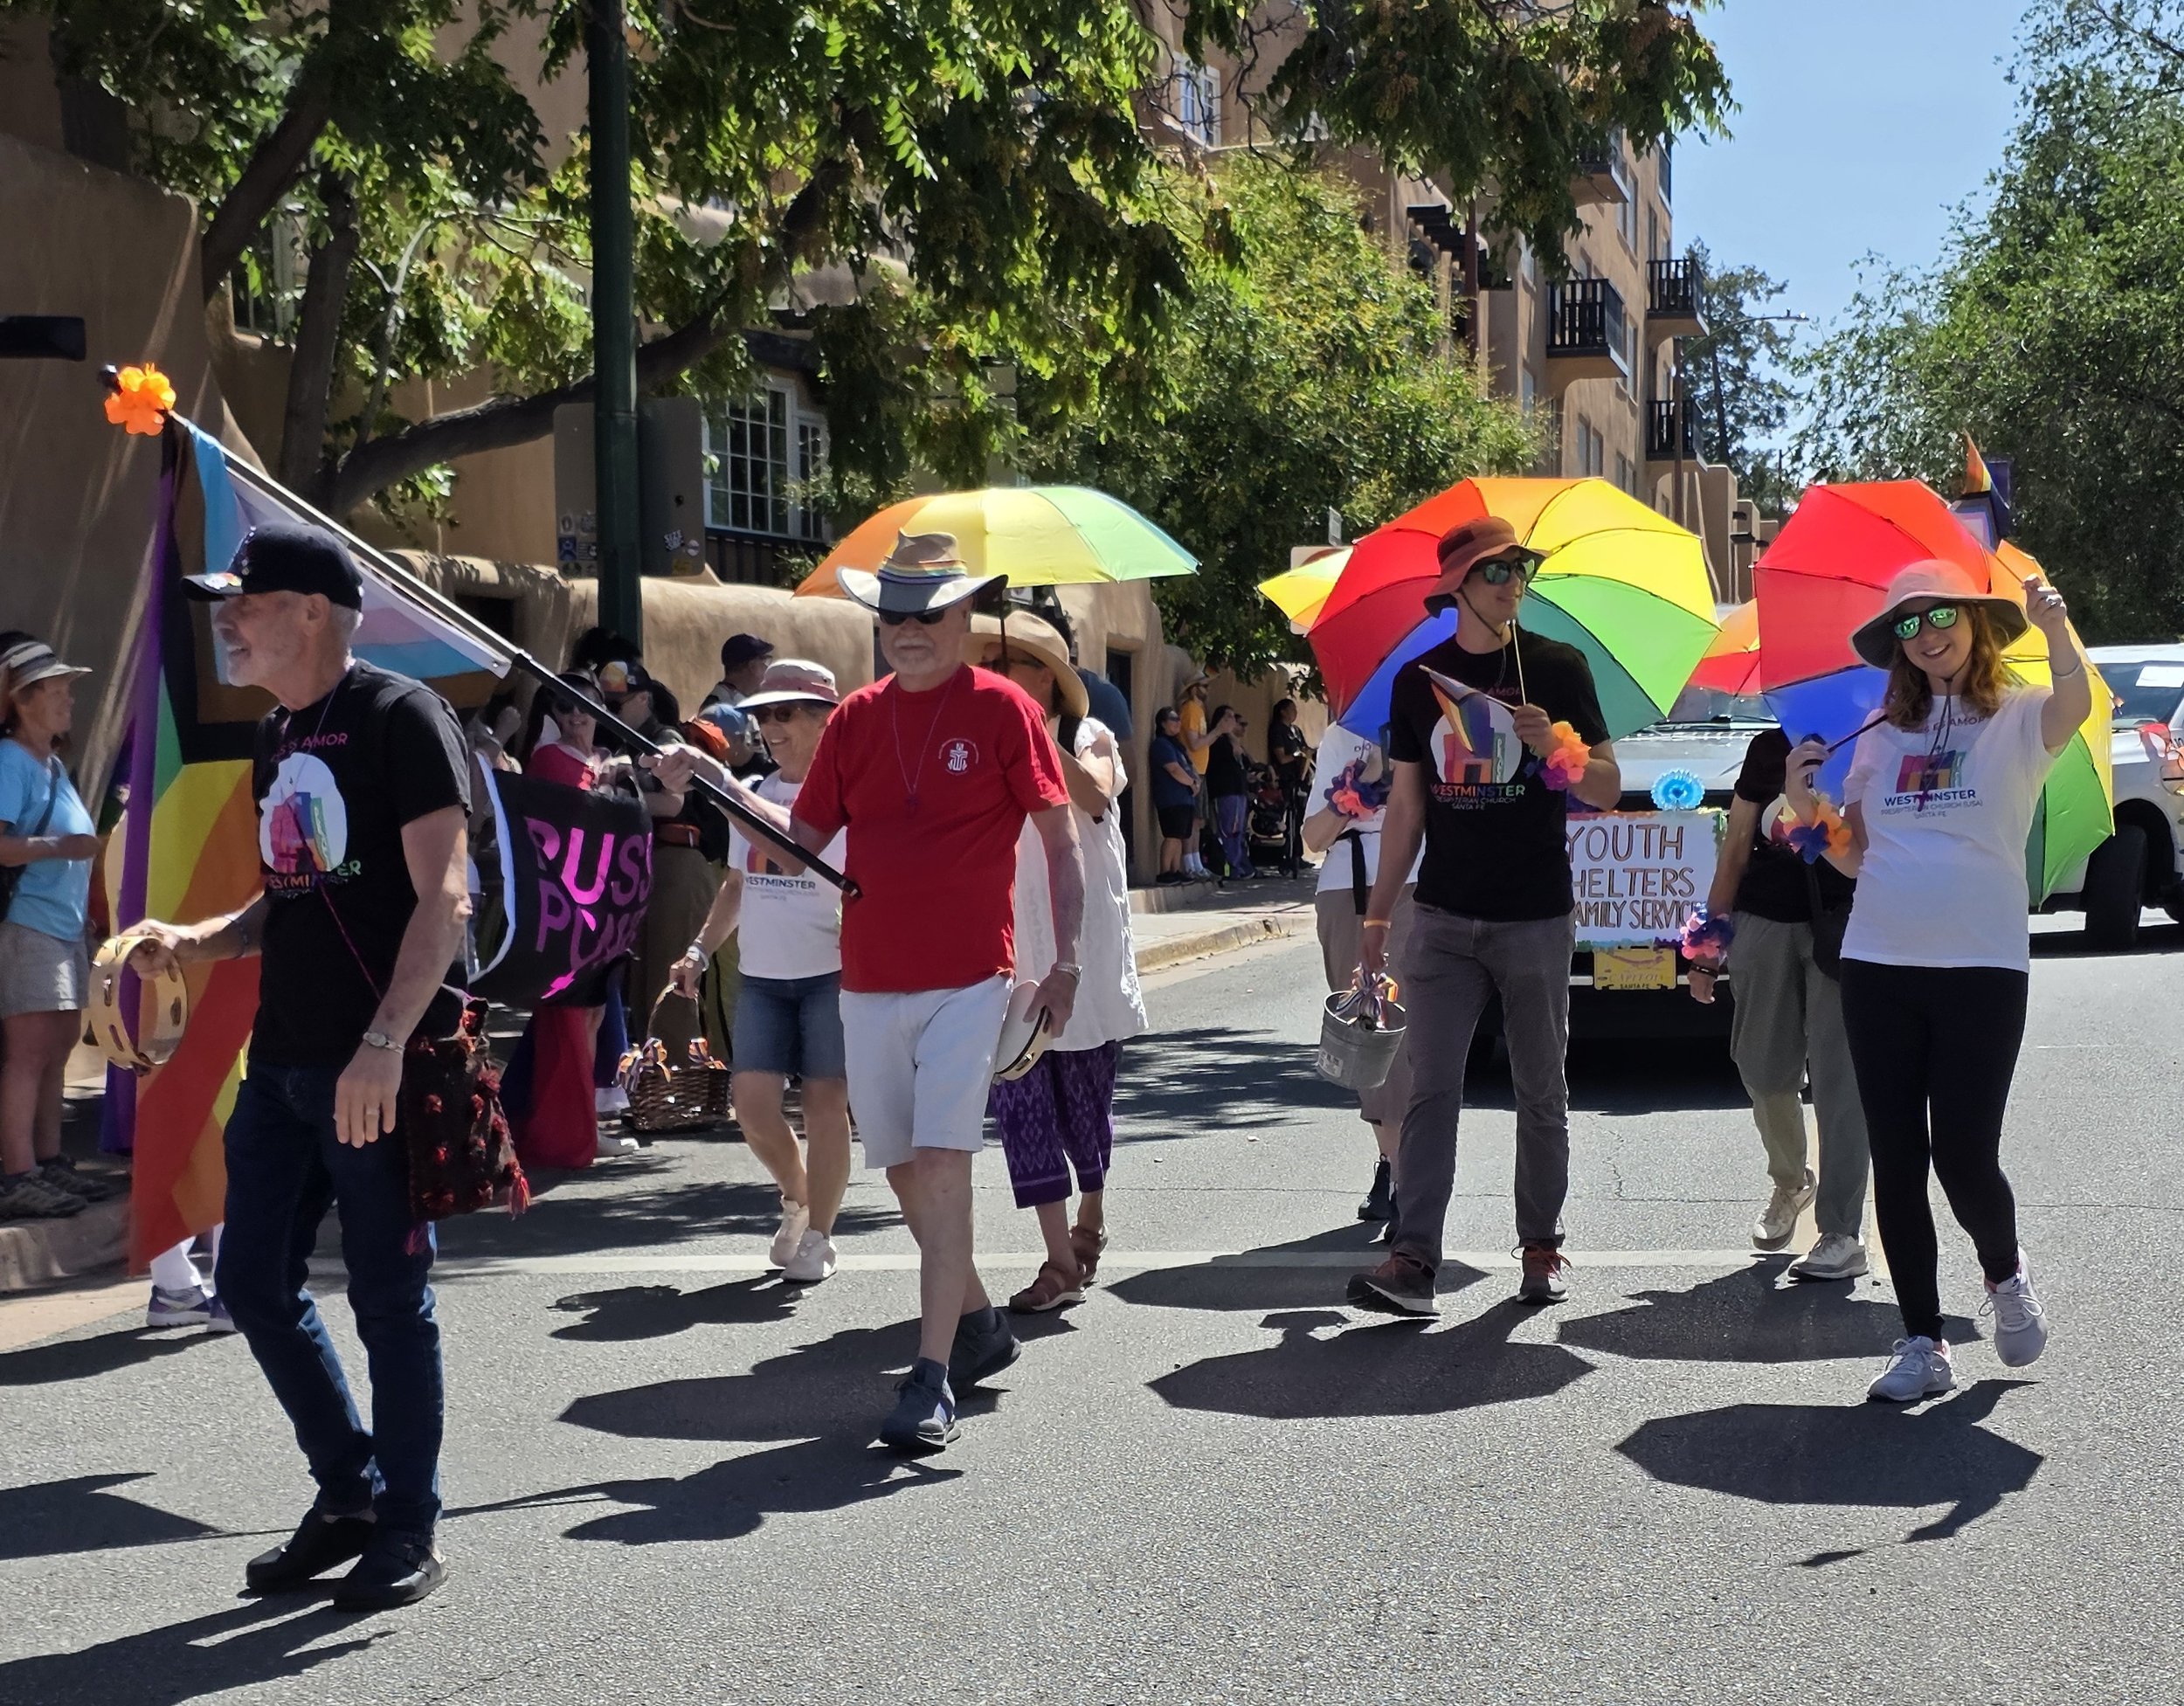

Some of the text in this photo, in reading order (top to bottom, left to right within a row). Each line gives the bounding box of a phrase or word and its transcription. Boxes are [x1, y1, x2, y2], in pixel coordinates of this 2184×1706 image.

[301, 732, 349, 749] AMOR
[1431, 784, 1526, 798] WESTMINSTER
[1566, 824, 1684, 863] YOUTH
